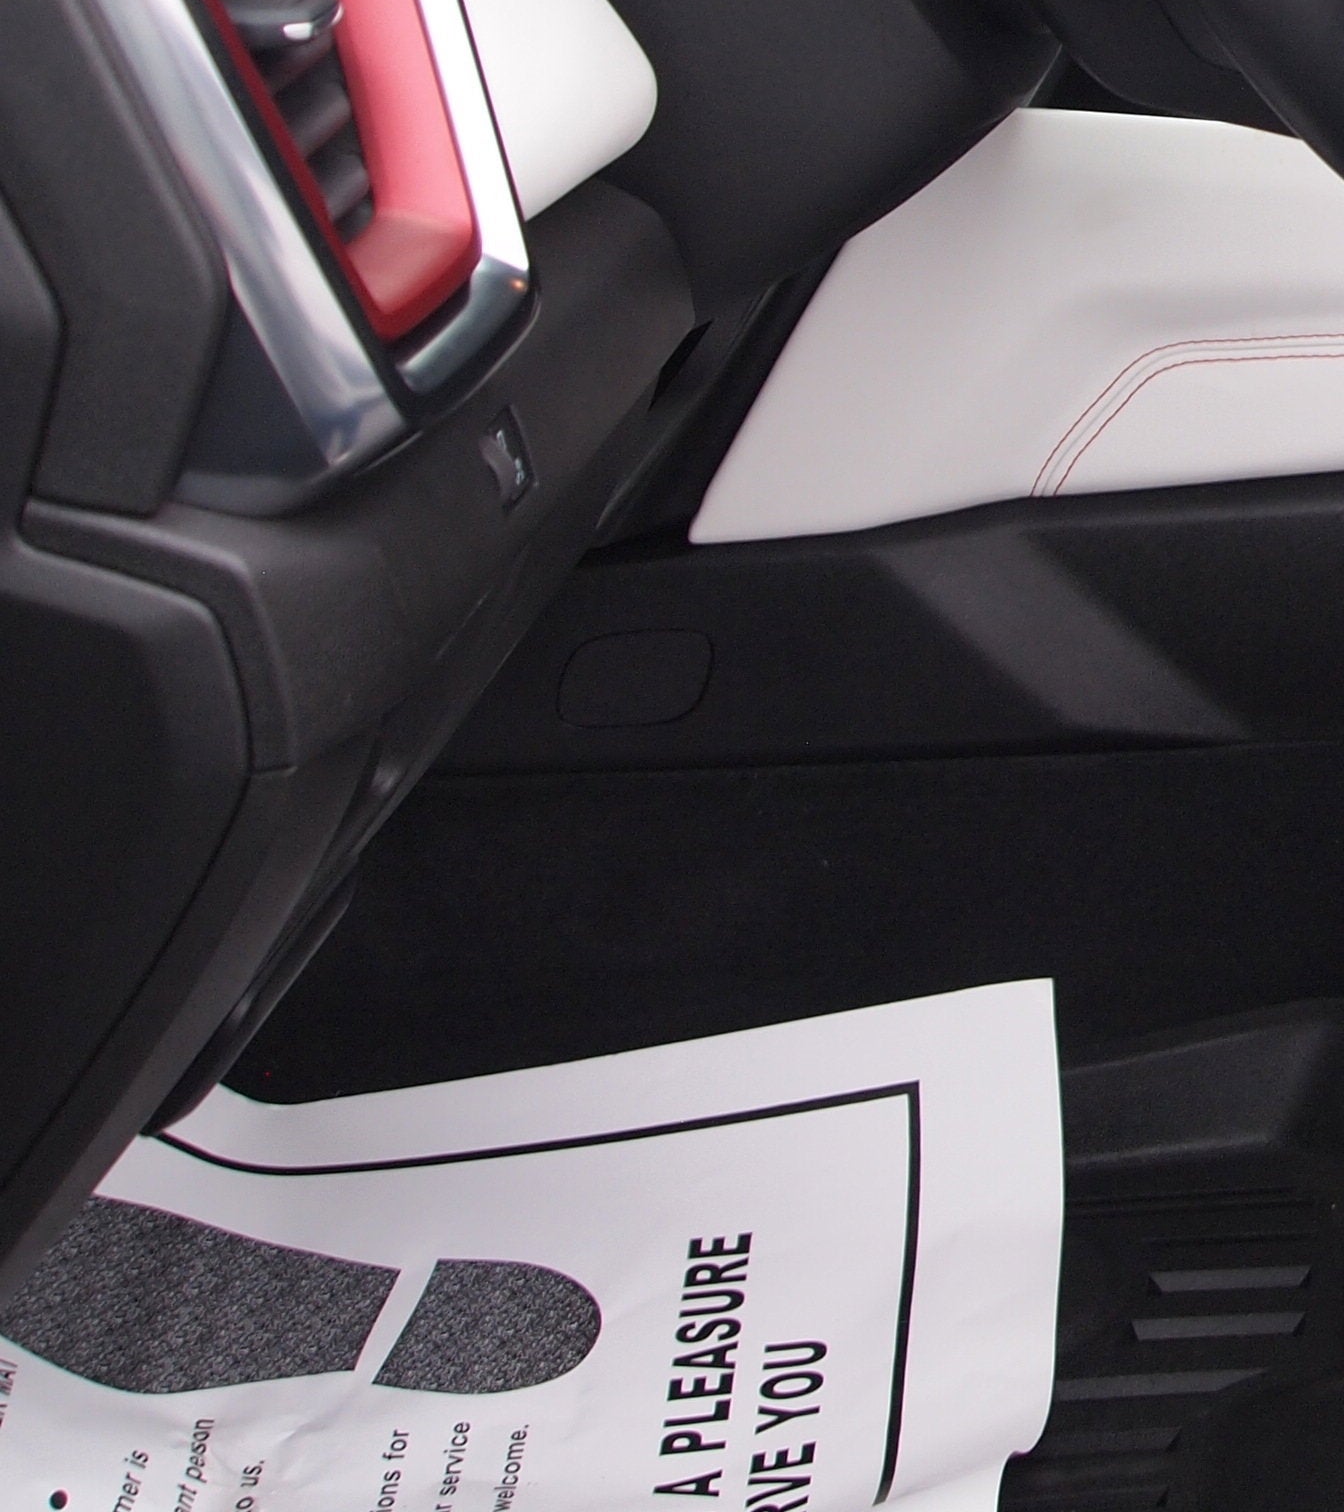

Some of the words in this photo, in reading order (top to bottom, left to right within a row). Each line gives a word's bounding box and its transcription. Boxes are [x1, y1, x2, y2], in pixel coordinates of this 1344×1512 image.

[658, 1231, 753, 1457] PLEASURE
[754, 1339, 828, 1436] YOU
[382, 1429, 410, 1461] for
[439, 1421, 471, 1497] service
[240, 1459, 266, 1489] us.
[652, 1469, 723, 1497] A
